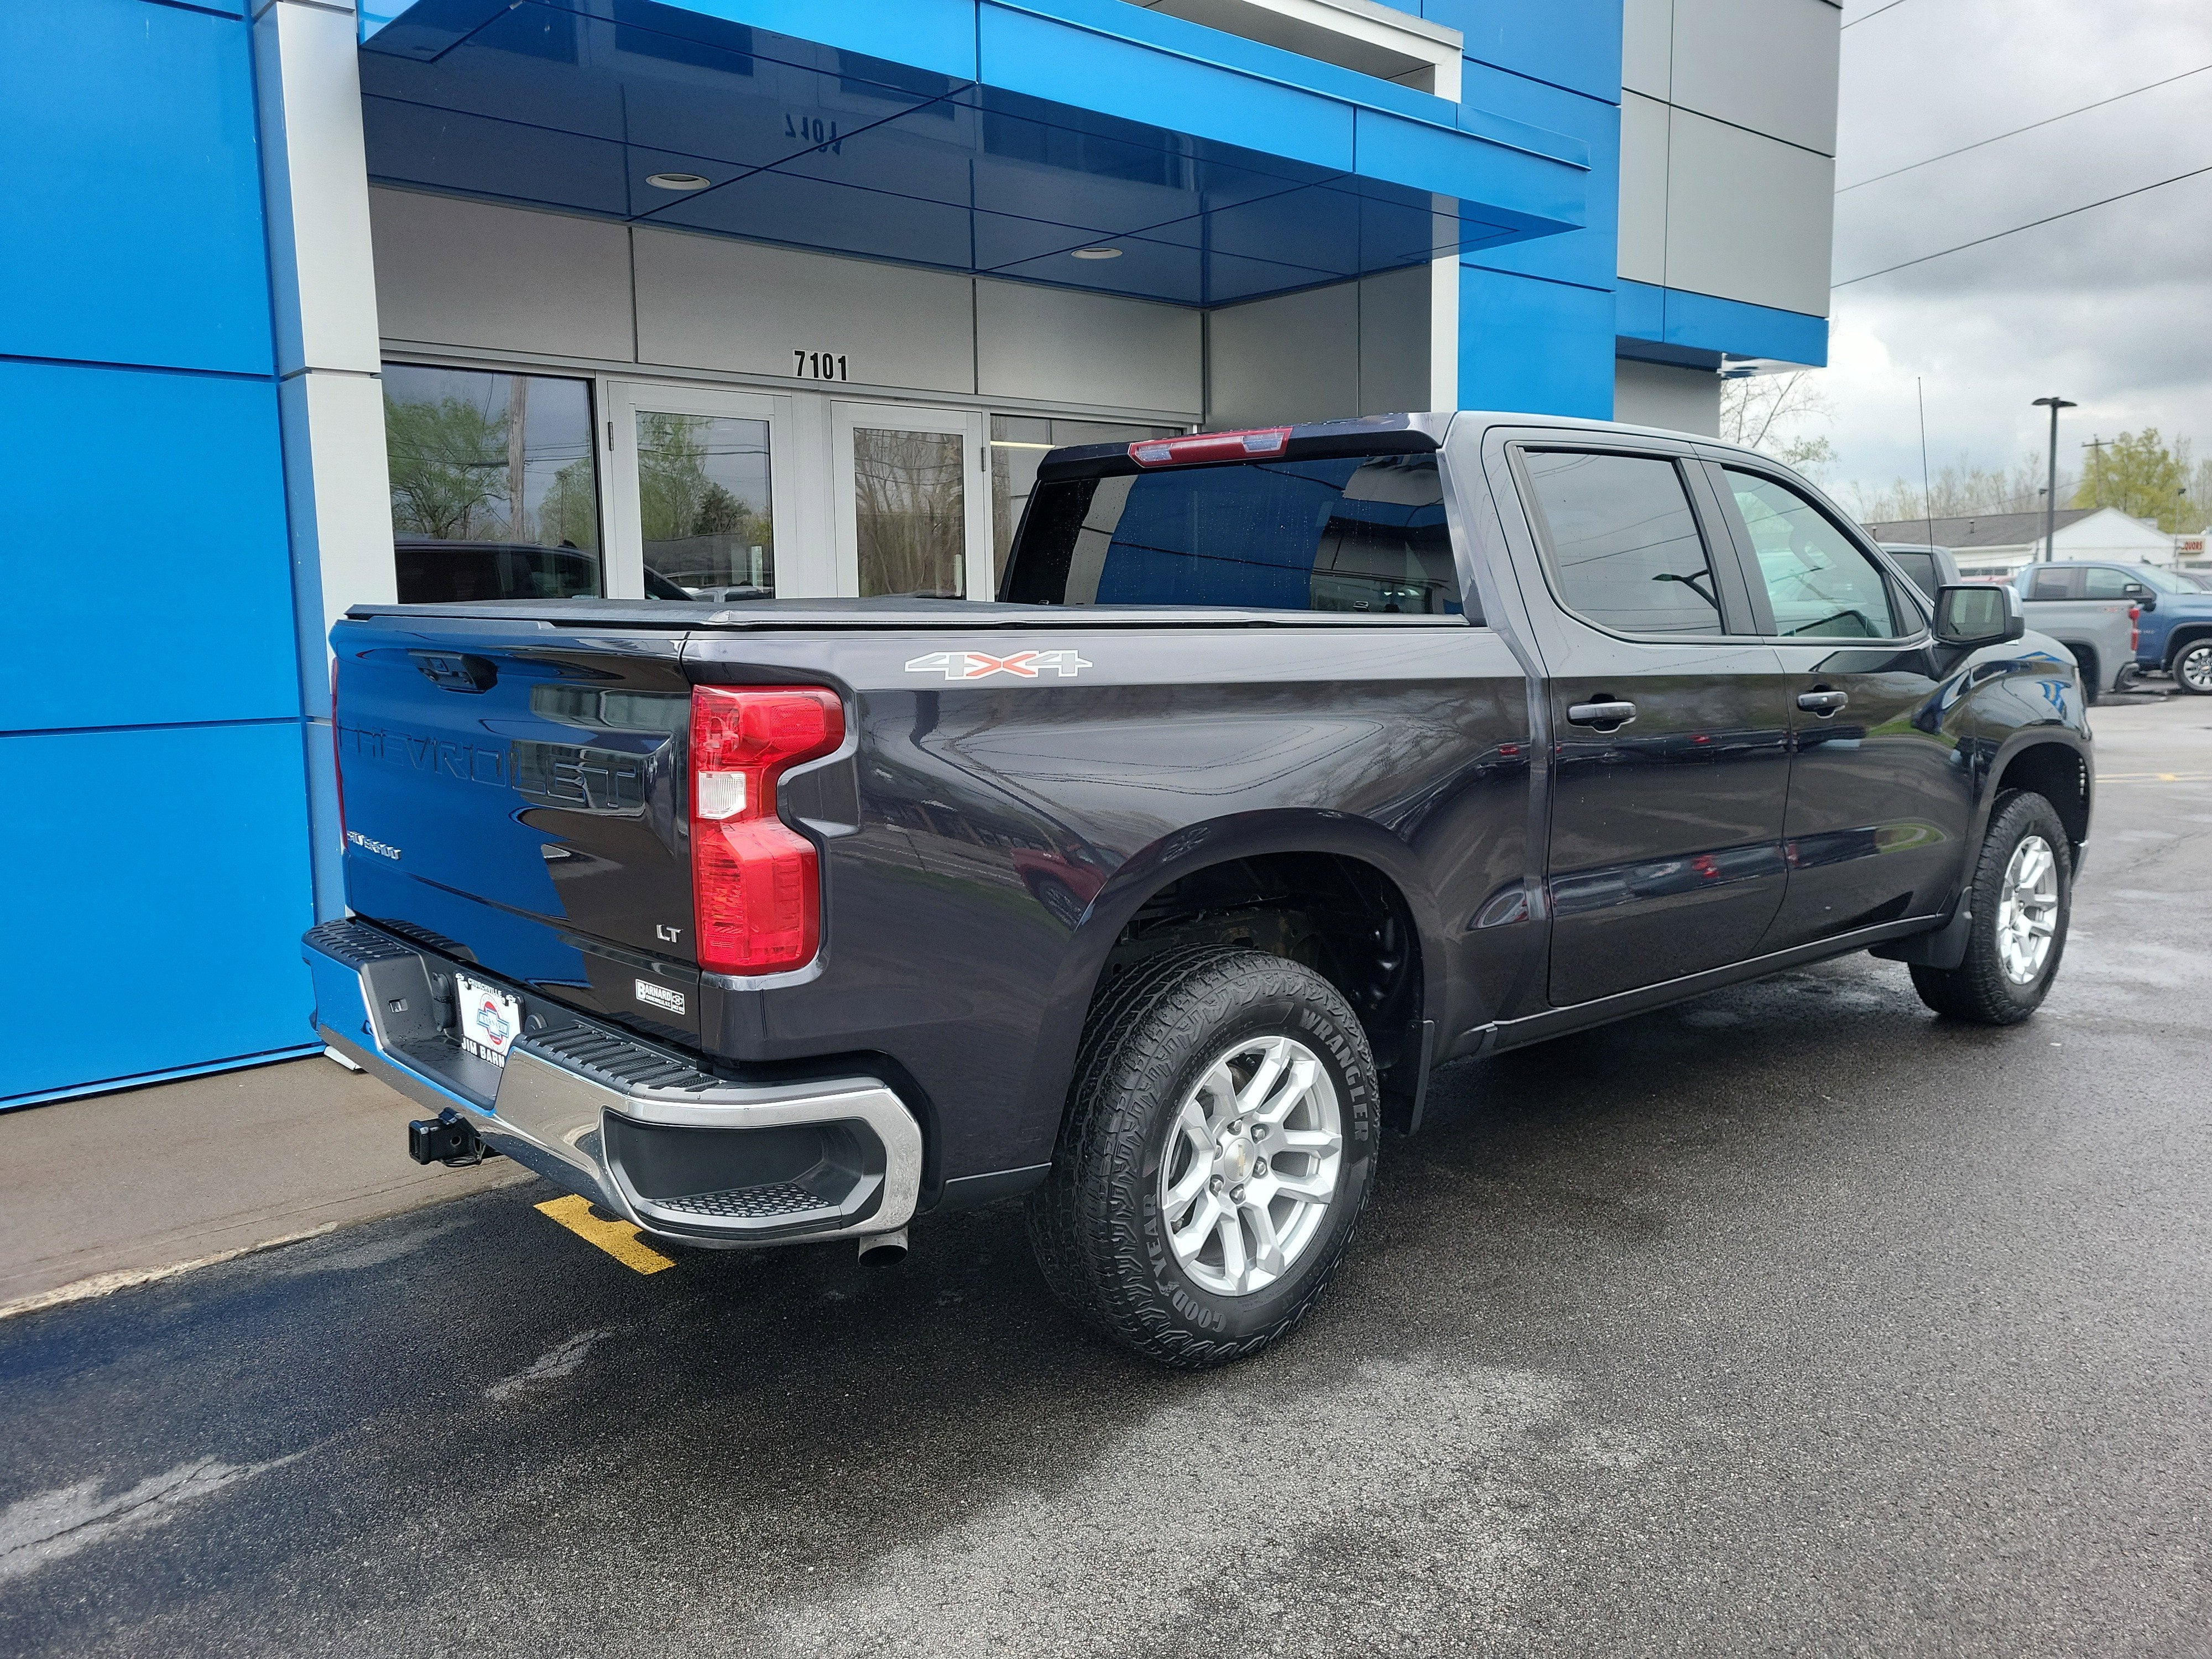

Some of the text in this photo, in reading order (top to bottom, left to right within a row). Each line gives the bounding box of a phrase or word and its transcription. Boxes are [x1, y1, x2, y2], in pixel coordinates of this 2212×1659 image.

[794, 350, 847, 380] 7101
[2180, 541, 2202, 550] QUORS
[656, 924, 683, 943] LT
[468, 978, 503, 998] CHURCHVILLE
[637, 982, 671, 1001] BARNARD
[461, 1037, 478, 1056] JIM
[1300, 1008, 1369, 1142] WRANGLER
